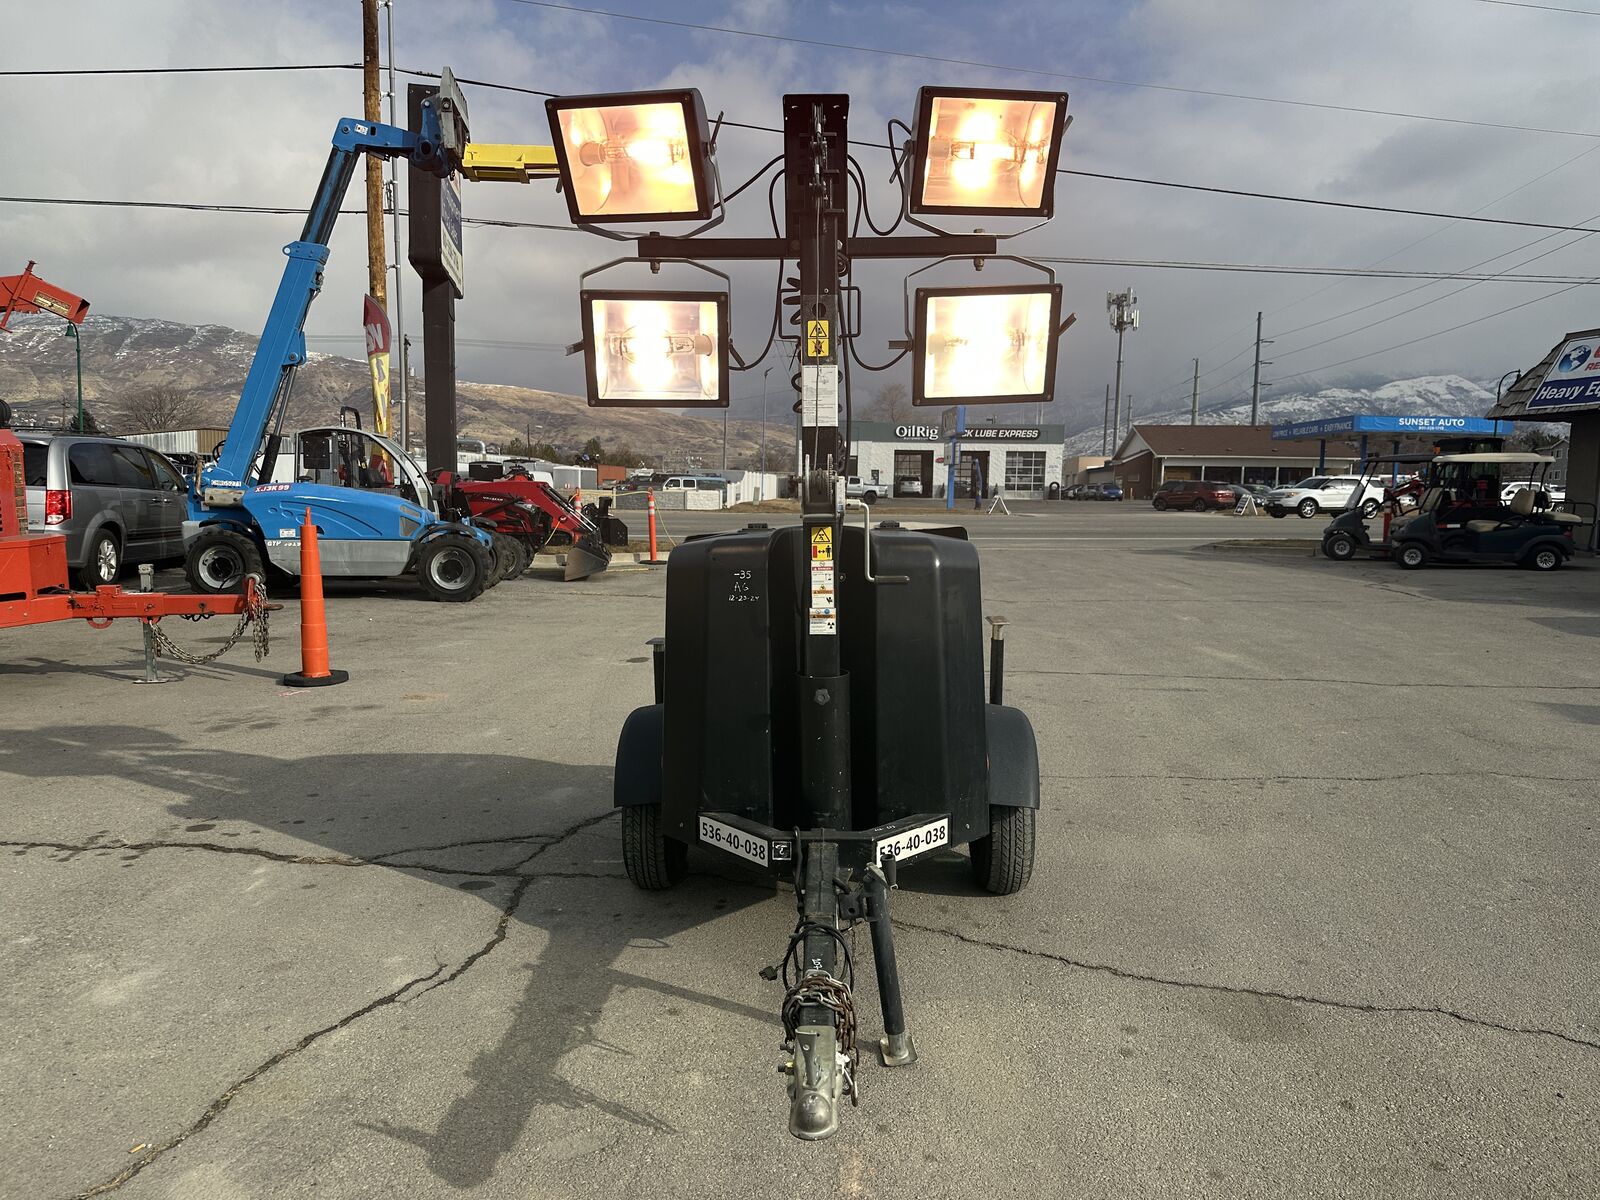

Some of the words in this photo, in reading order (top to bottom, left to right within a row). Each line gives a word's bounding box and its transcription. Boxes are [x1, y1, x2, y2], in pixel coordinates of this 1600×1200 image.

[1535, 385, 1585, 400] Heavy
[1398, 417, 1437, 426] SUNSET
[1438, 418, 1465, 427] AUTO
[895, 425, 939, 441] OilRig
[974, 429, 998, 438] LUBE
[998, 429, 1039, 438] EXPRESS
[701, 822, 766, 861] 536-40-038
[879, 825, 946, 857] 536-40-038
